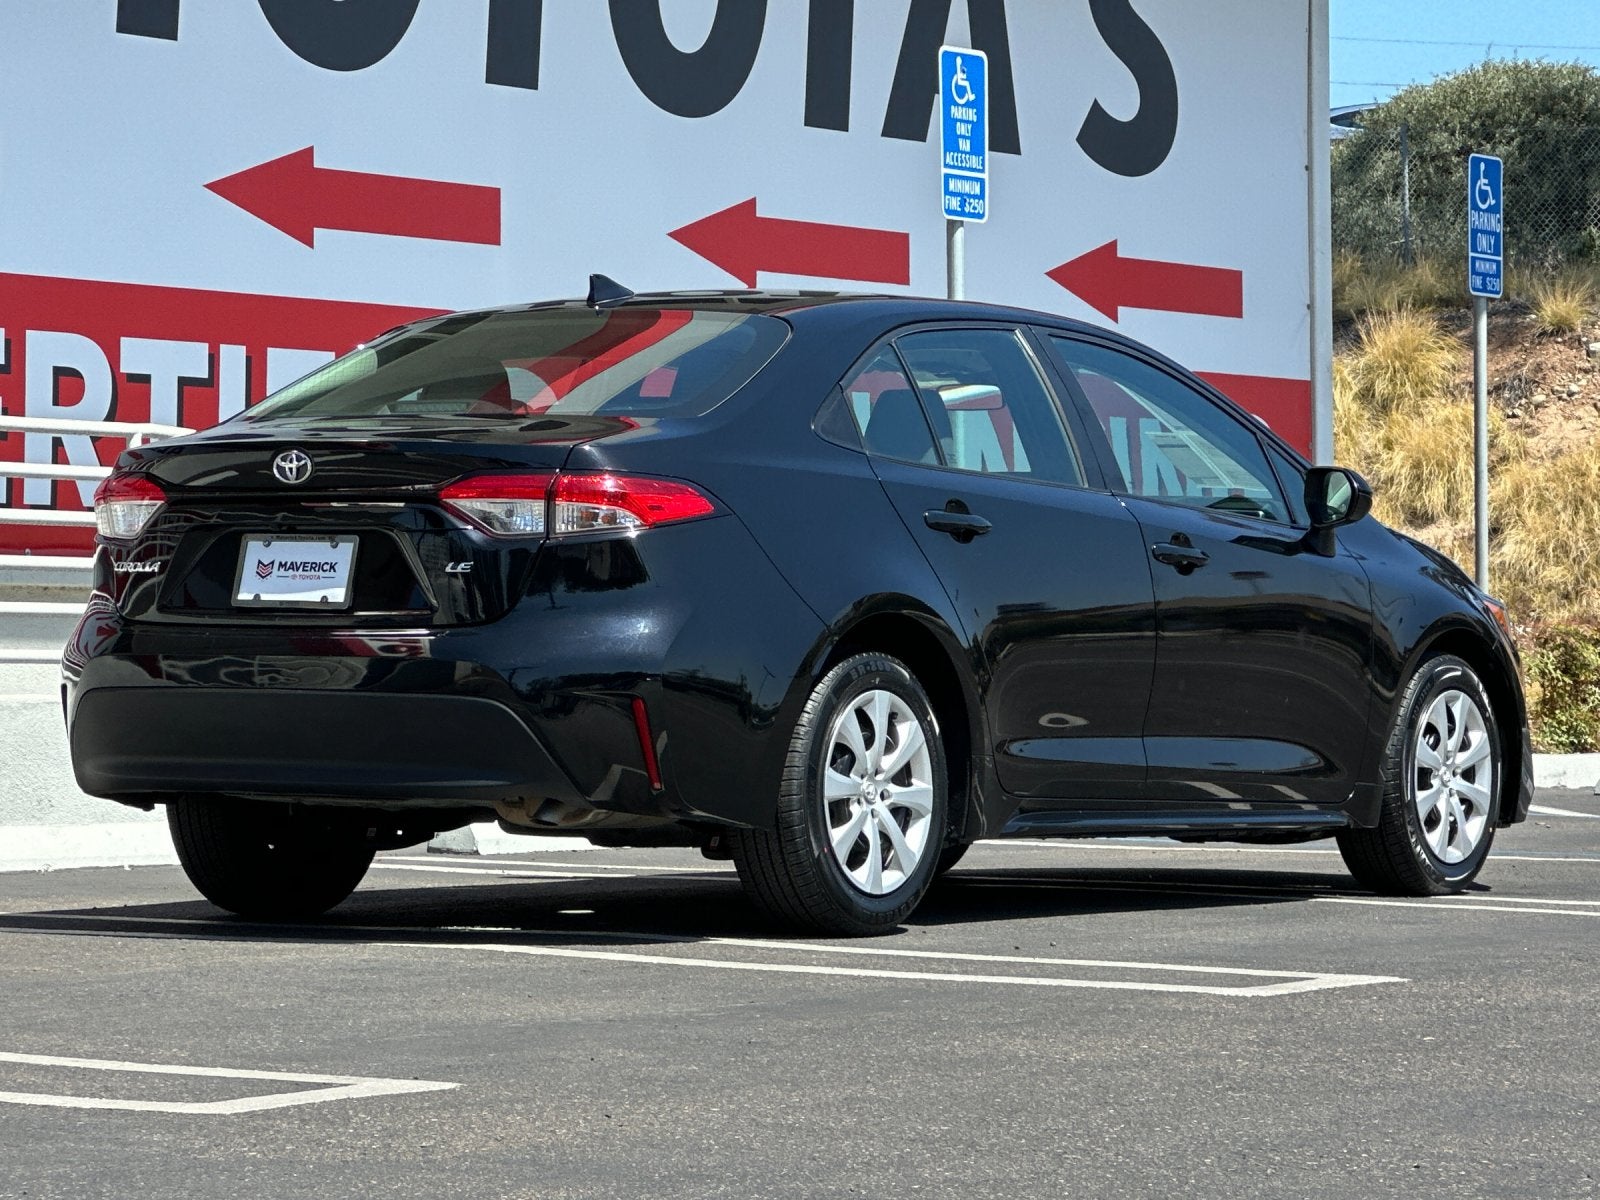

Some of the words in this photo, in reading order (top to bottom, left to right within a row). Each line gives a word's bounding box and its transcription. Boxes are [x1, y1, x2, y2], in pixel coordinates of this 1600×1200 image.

[950, 105, 977, 122] PARKING
[956, 121, 972, 136] ONLY
[958, 138, 971, 152] VAN
[945, 151, 983, 170] ACCESSIBLE
[948, 178, 981, 196] MINIMUM
[945, 195, 962, 211] FINE
[963, 196, 984, 215] $250
[1471, 210, 1501, 233] PARKING
[1476, 232, 1495, 254] ONLY
[1475, 260, 1497, 275] MINIMUM
[1472, 275, 1483, 289] FINE
[277, 560, 339, 573] MAVERICK
[445, 561, 474, 573] LE
